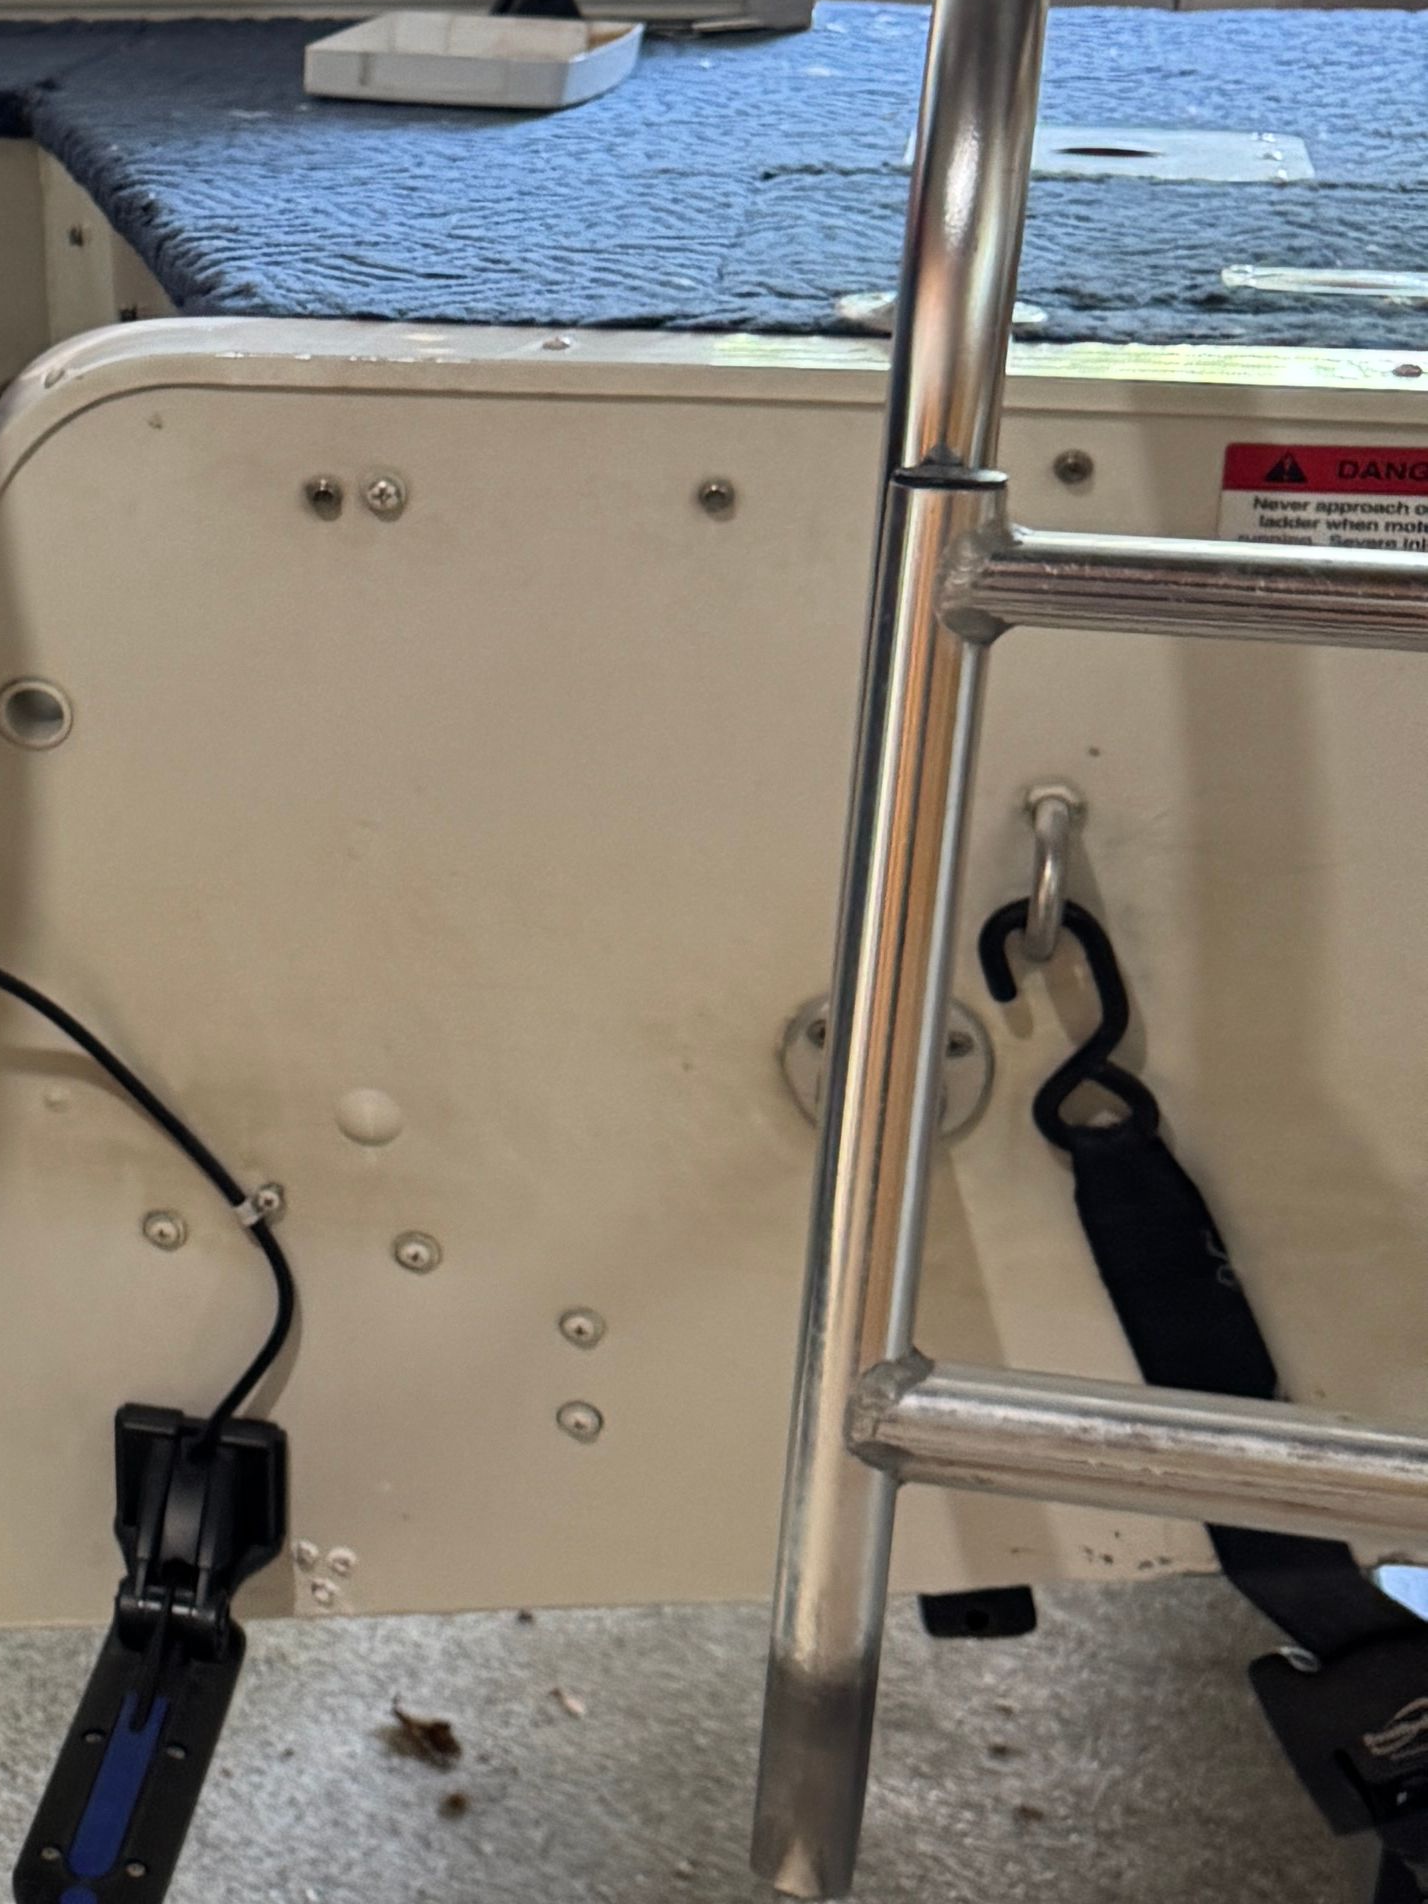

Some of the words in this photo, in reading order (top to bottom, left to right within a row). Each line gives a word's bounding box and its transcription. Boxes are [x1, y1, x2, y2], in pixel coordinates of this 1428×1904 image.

[1253, 495, 1312, 511] Never
[1315, 500, 1410, 517] approach
[1258, 515, 1320, 529] ladder
[1326, 517, 1379, 532] when
